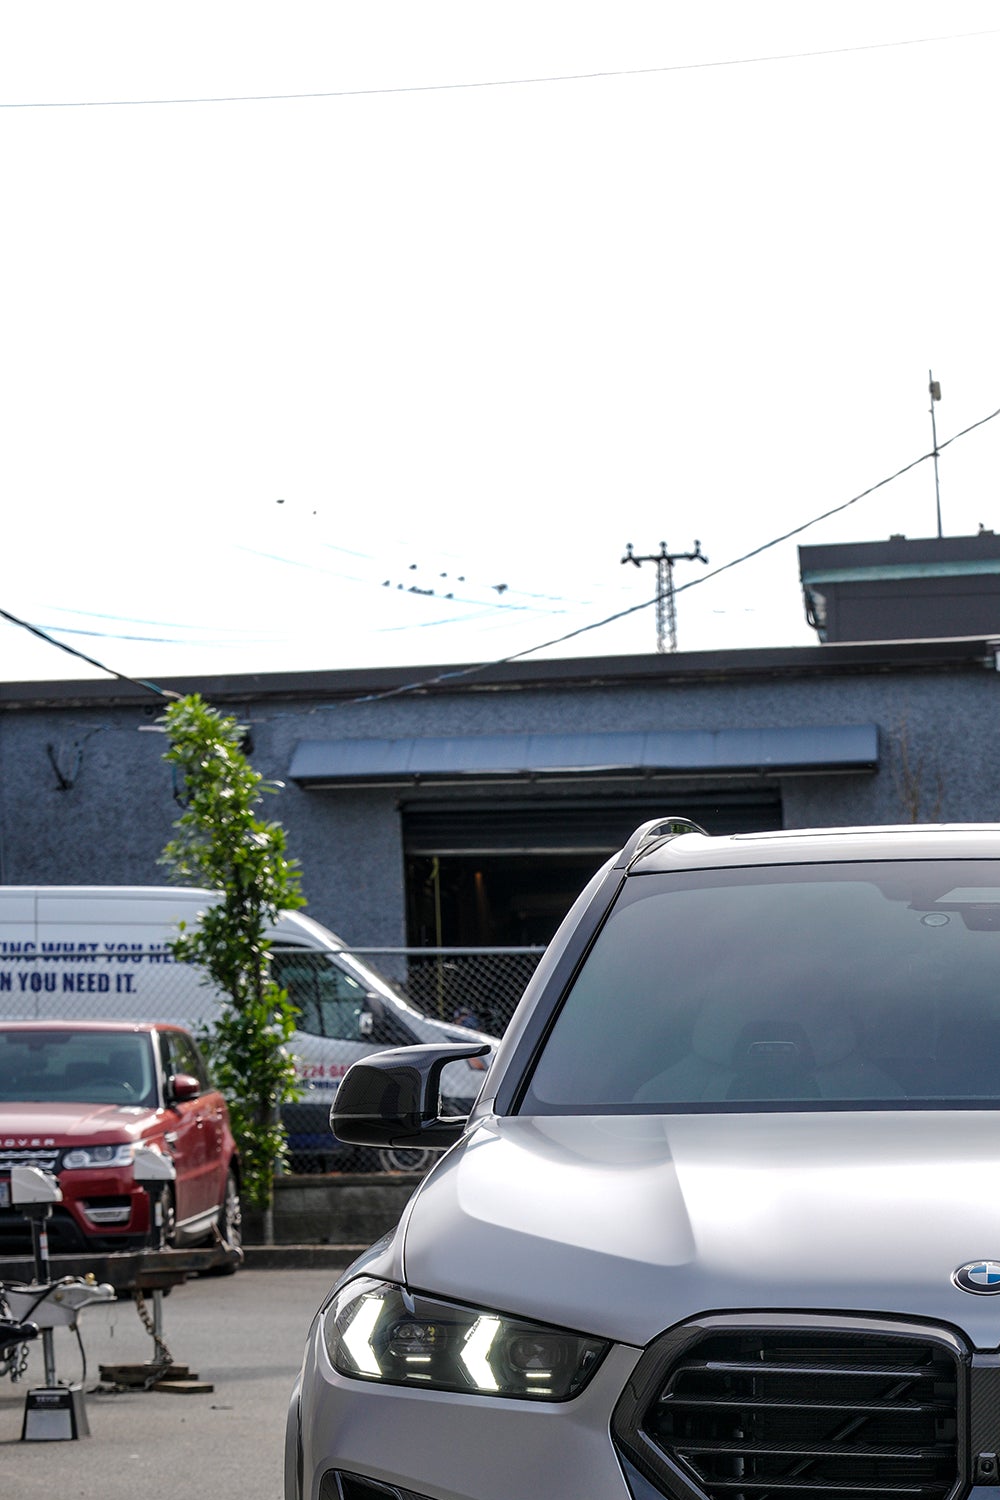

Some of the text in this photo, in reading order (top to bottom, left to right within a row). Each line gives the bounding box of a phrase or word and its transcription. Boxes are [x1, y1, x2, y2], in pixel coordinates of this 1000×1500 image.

[41, 942, 100, 963] WHAT
[104, 943, 143, 964] YOU
[18, 972, 56, 993] YOU
[63, 973, 110, 993] NEED
[116, 974, 137, 993] IT.
[0, 1138, 55, 1147] OVER
